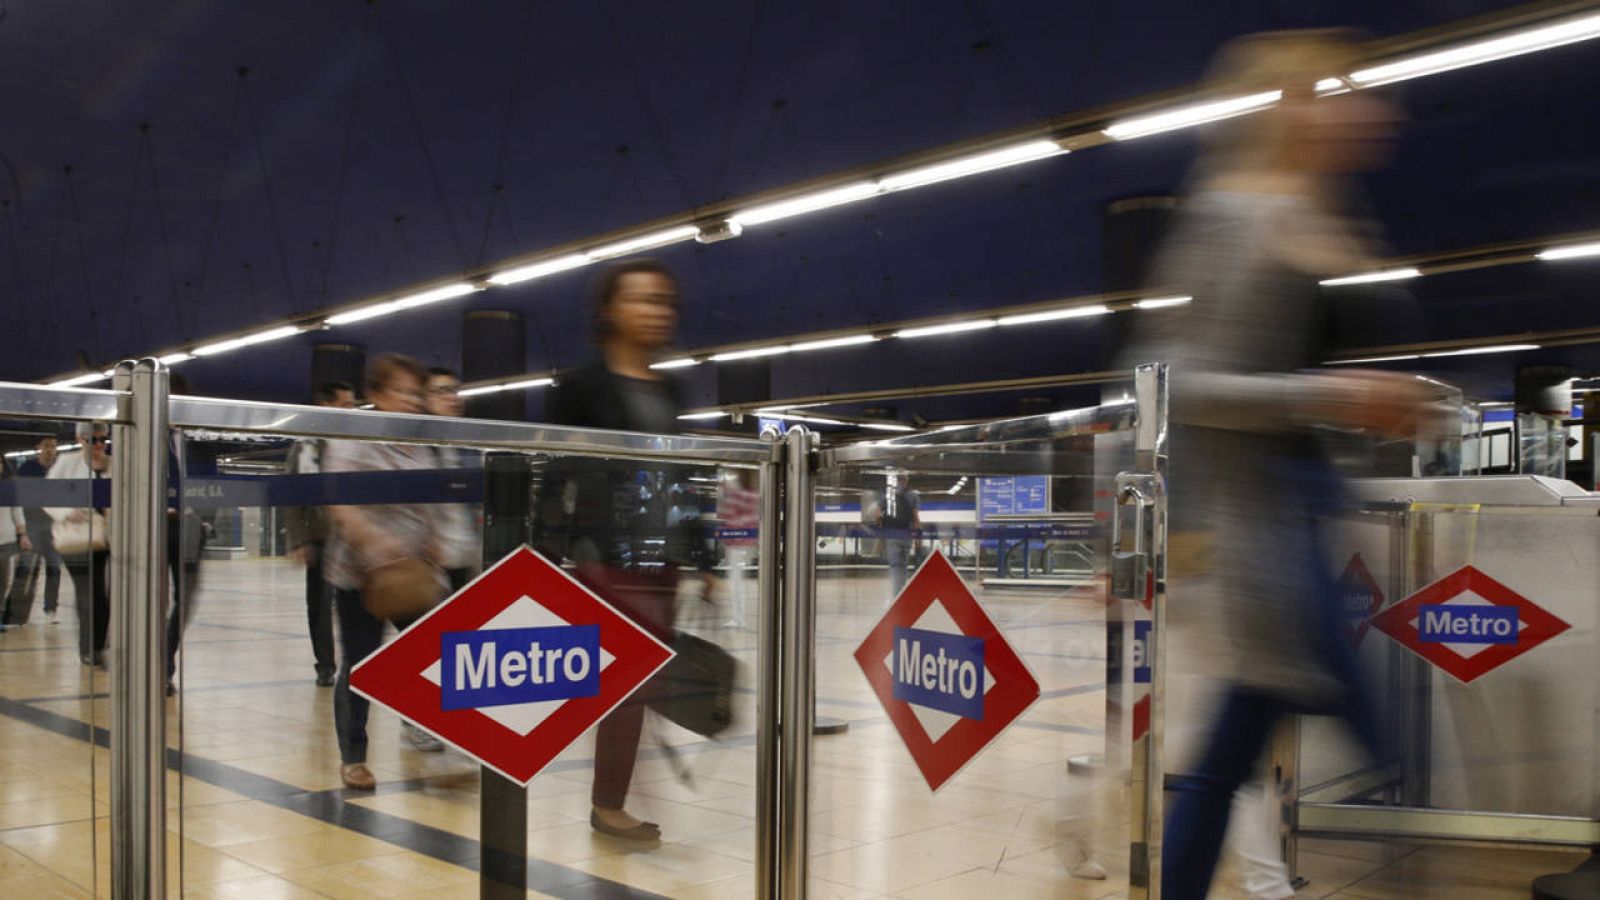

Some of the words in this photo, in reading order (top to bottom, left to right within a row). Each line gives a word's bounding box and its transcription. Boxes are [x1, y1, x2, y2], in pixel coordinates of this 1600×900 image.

[1425, 610, 1512, 636] Metro
[455, 641, 591, 691] Metro
[899, 638, 977, 699] Metro
